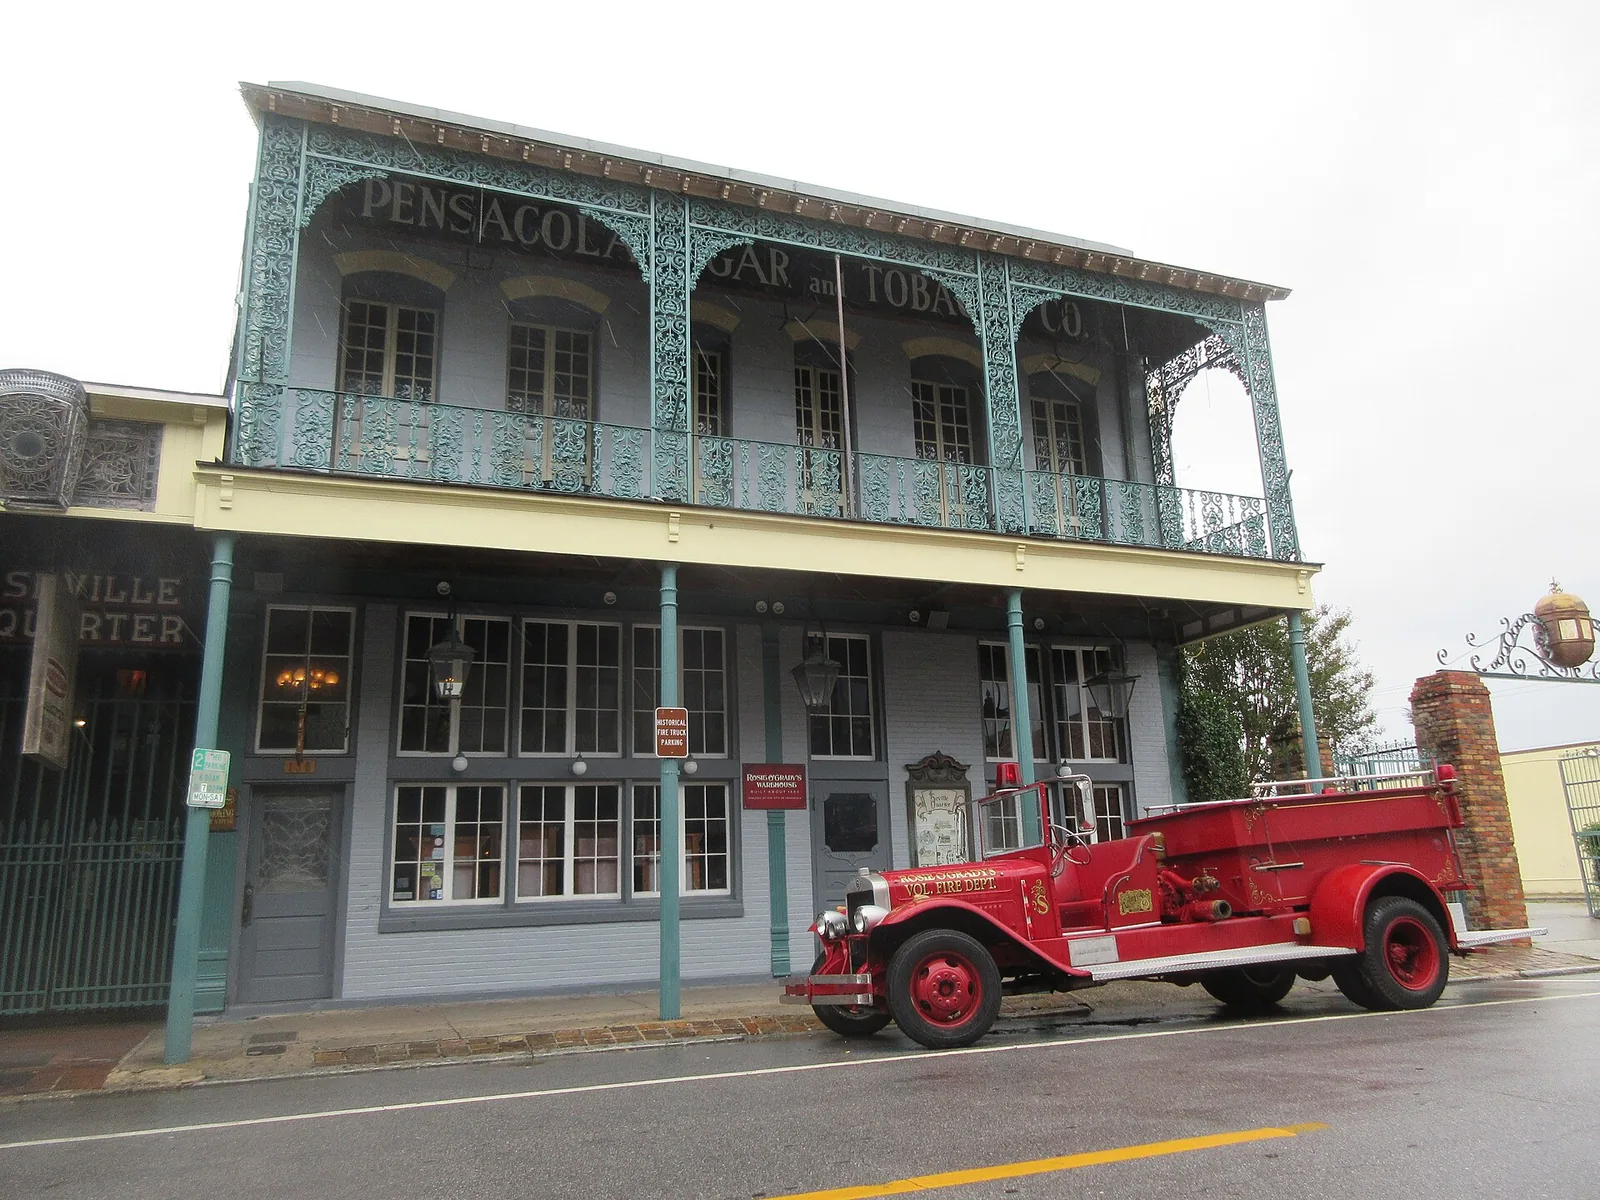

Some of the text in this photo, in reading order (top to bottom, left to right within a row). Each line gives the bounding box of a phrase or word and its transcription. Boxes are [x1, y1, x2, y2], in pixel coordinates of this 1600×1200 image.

[360, 177, 637, 264] PENSACOLA
[704, 243, 792, 289] GAR
[861, 265, 972, 319] TOBA
[0, 607, 183, 643] QRTER
[194, 752, 204, 767] 2
[746, 773, 802, 782] ROSIE O'GRADY'S
[193, 793, 223, 802] MON-SAT
[900, 872, 935, 883] ROSIE
[904, 877, 997, 896] VOL. FIRE DEPT.
